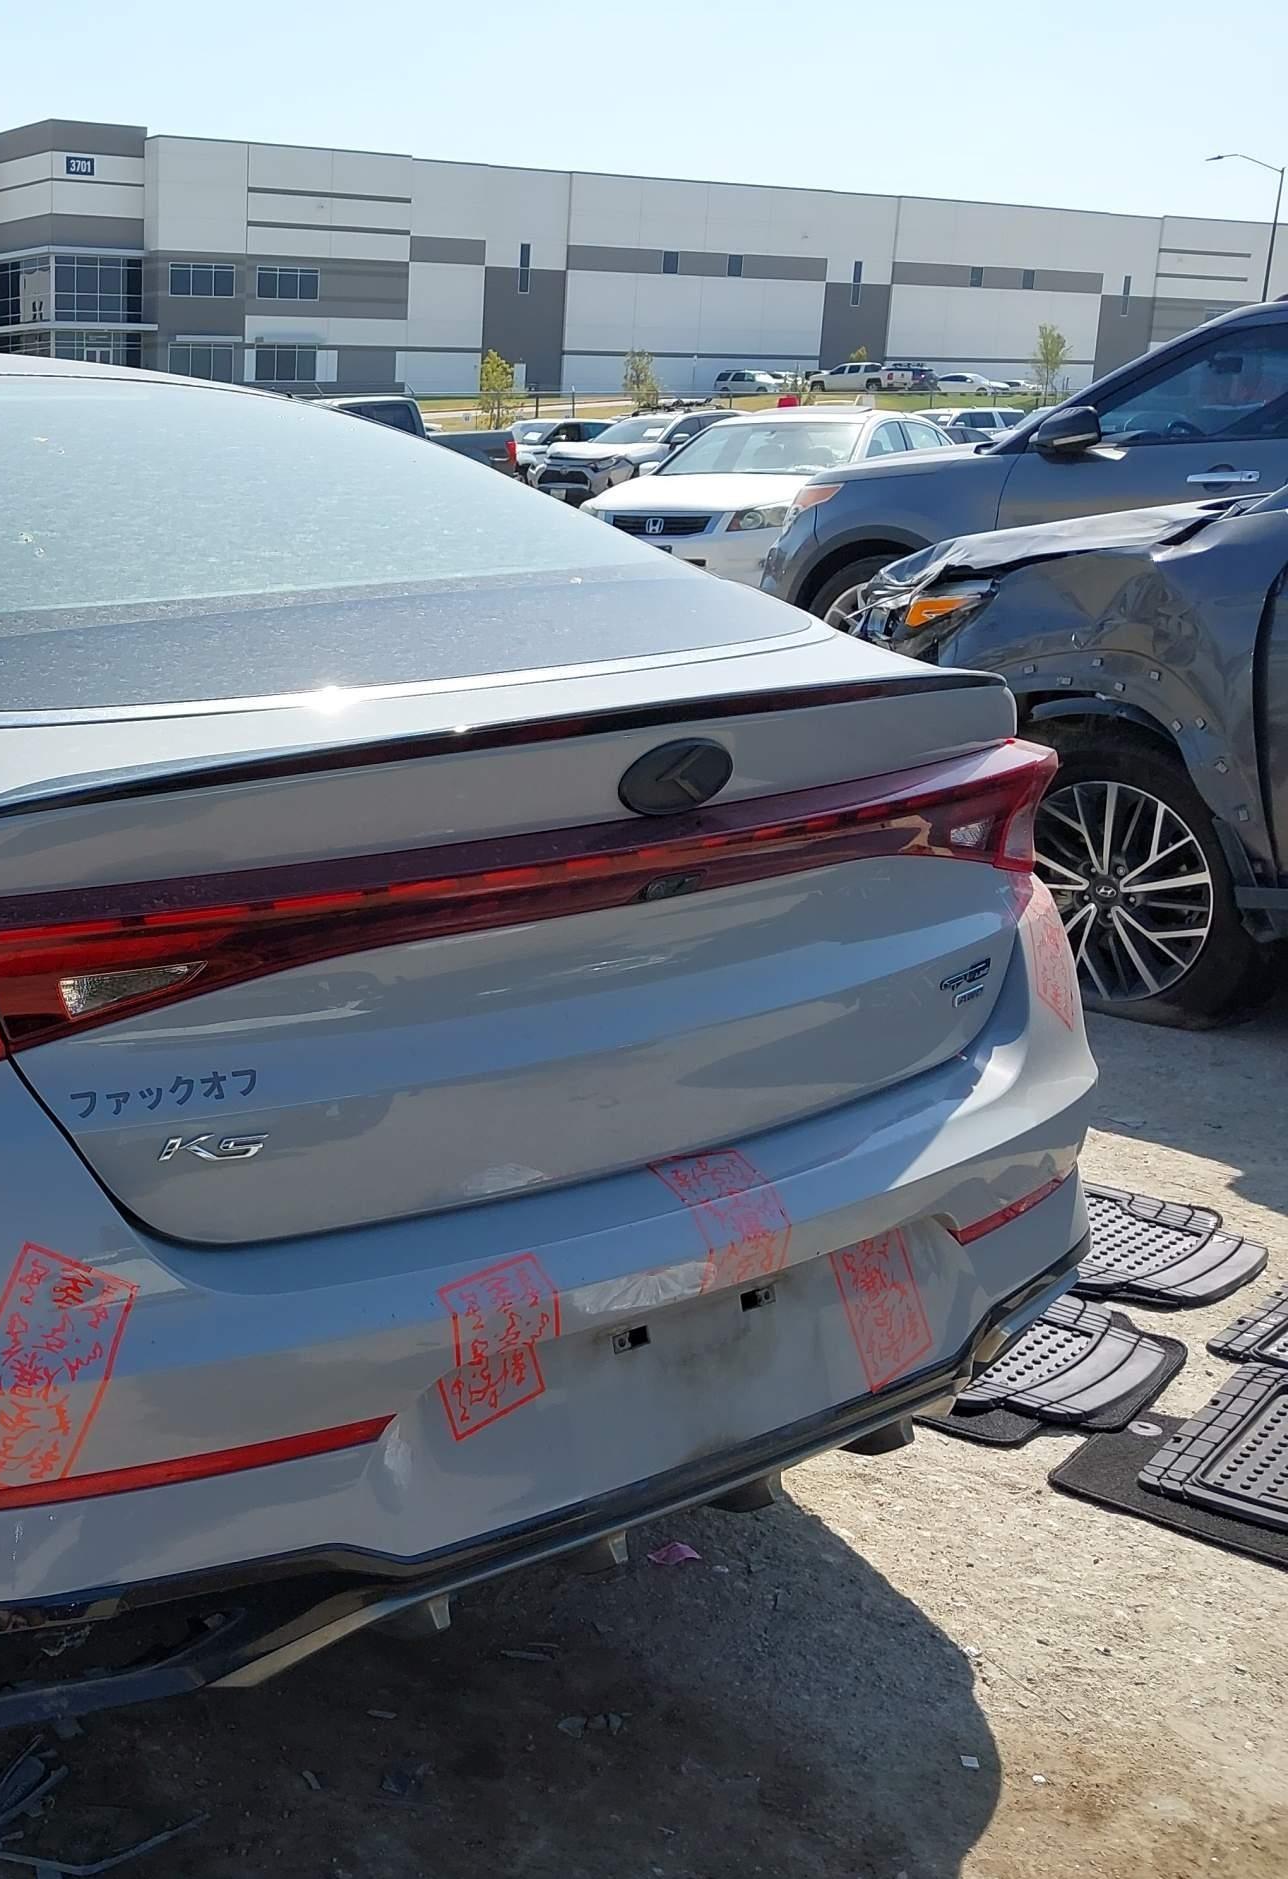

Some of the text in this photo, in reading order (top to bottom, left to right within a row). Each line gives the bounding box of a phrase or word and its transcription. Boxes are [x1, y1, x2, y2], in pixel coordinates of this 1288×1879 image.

[70, 160, 91, 173] 3701
[70, 1068, 257, 1118] ファックオフ
[158, 1133, 270, 1162] K5
